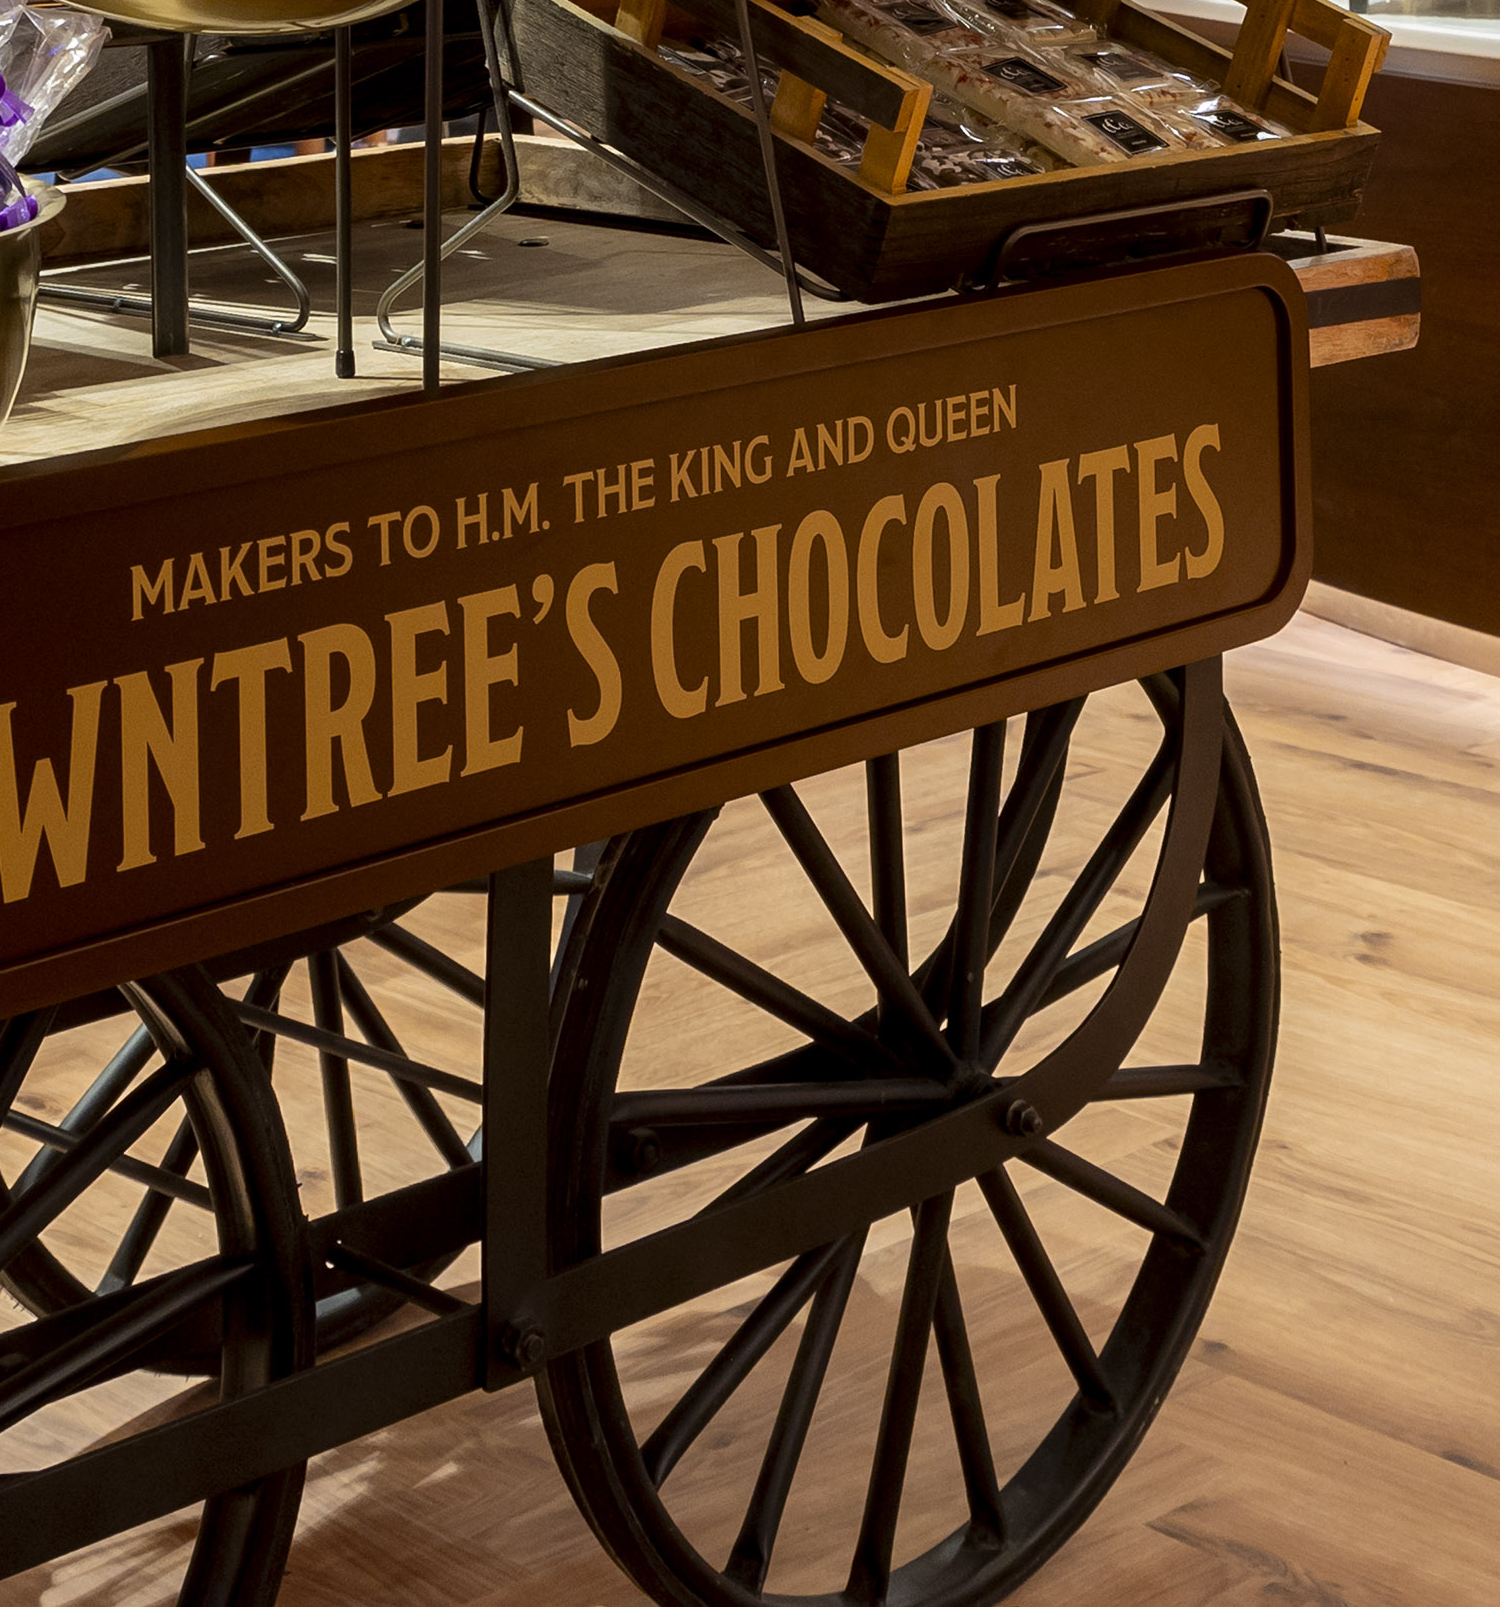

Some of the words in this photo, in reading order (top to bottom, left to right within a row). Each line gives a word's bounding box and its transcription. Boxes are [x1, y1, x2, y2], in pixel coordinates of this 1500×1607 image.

[130, 521, 353, 621] MAKERS
[367, 505, 441, 567] TO
[455, 482, 551, 550] H.M.
[562, 458, 656, 524] THE
[668, 434, 773, 503] KING
[785, 415, 875, 478] AND
[885, 384, 1017, 455] QUEEN
[650, 422, 1225, 719] CHOCOLATES
